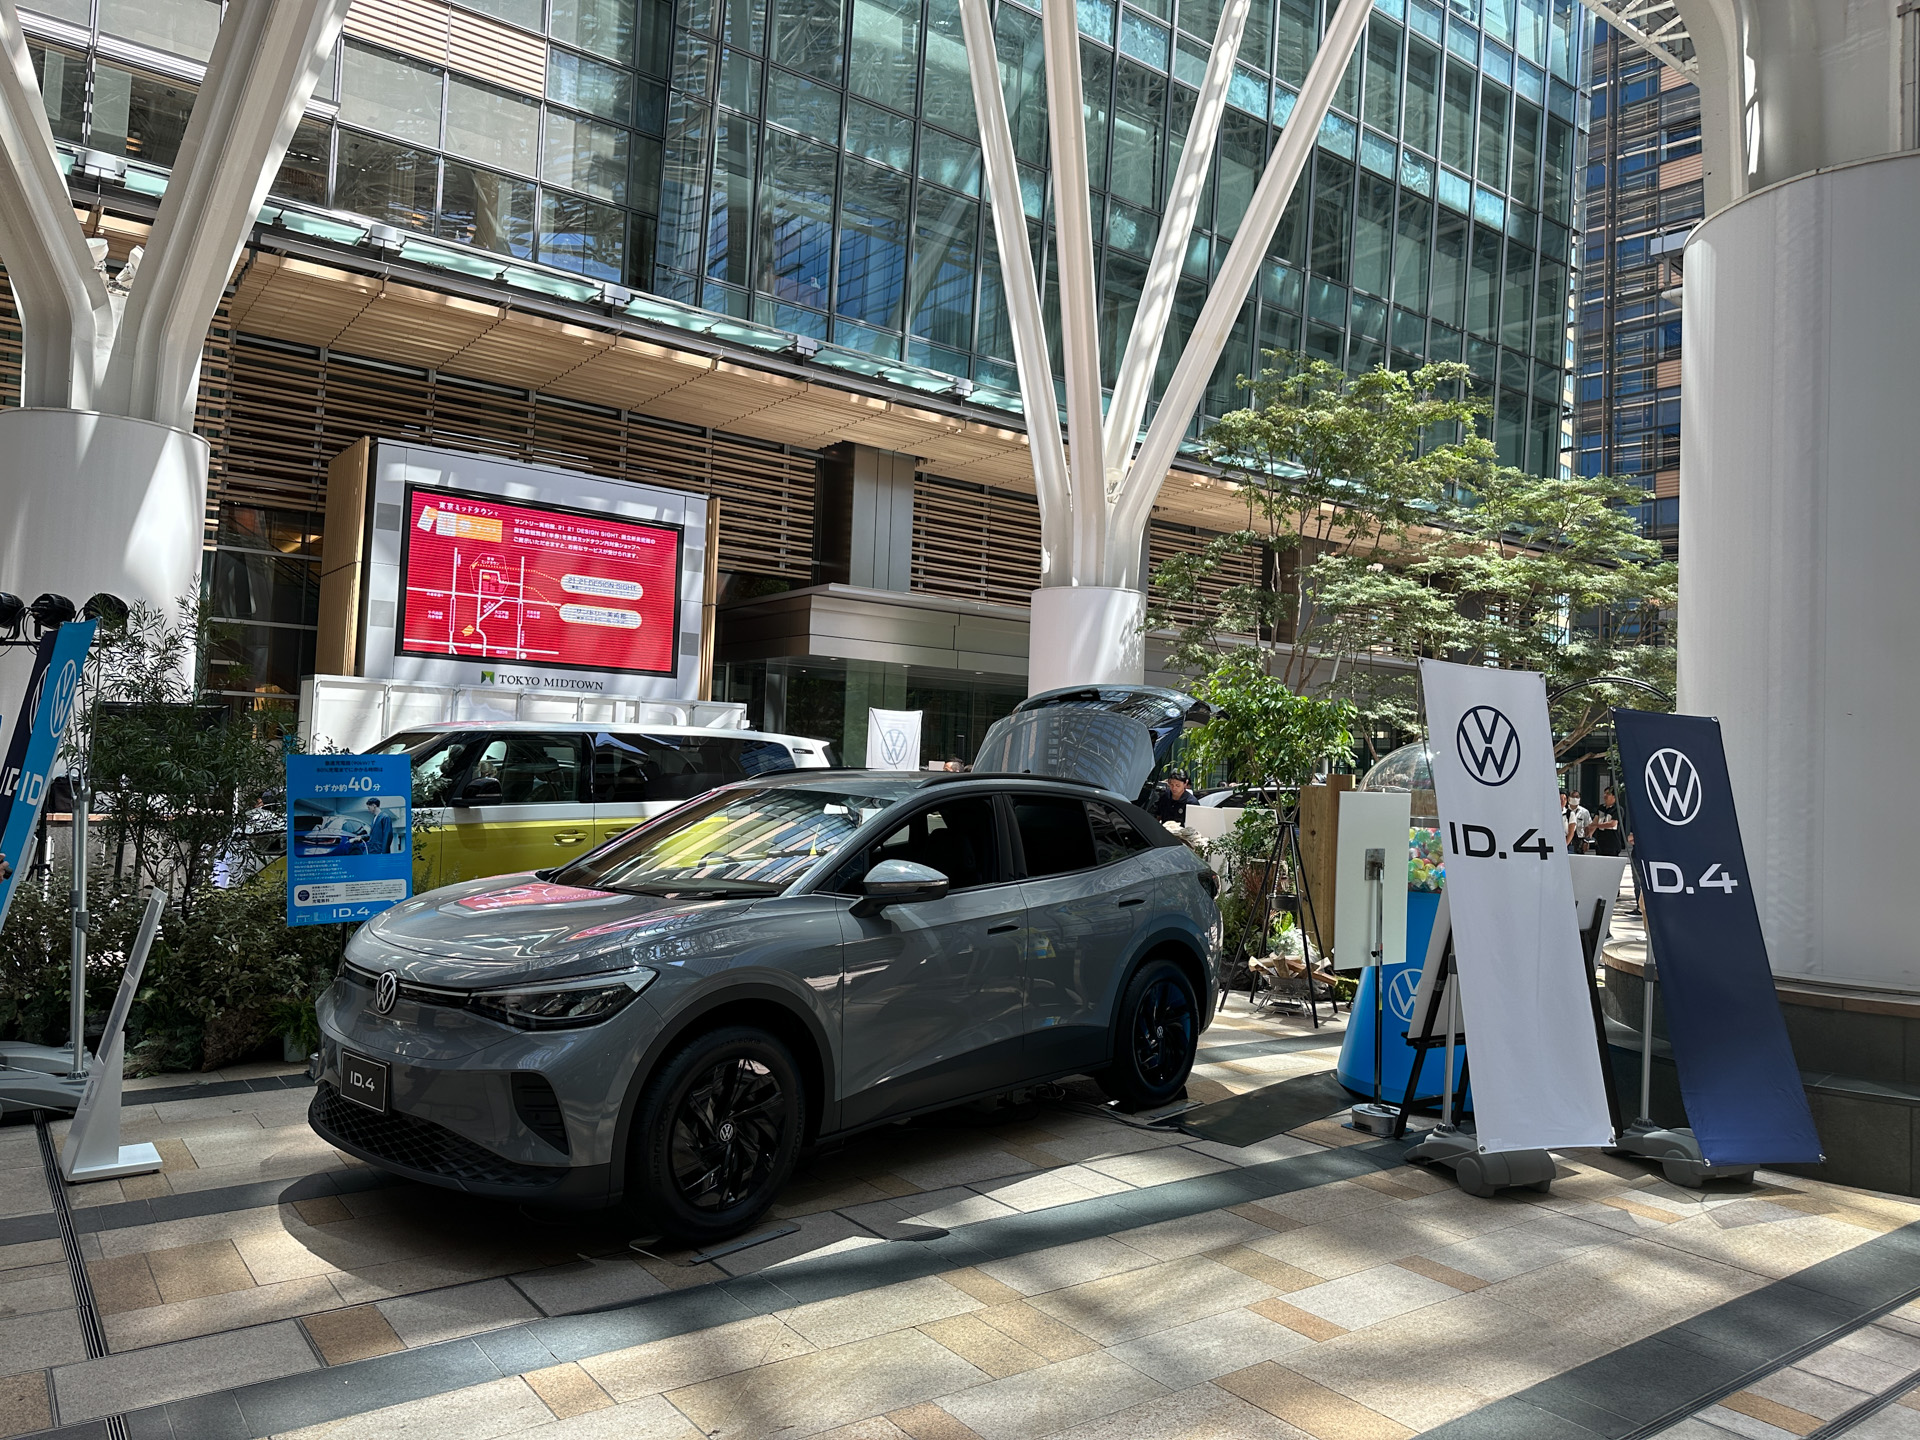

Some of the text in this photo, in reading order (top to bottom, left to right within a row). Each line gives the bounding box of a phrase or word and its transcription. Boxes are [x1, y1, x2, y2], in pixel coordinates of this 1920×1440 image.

[498, 674, 604, 691] TOKYO MIDTOWN
[314, 776, 381, 793] わずか約40分
[1449, 821, 1555, 861] ID.4
[332, 906, 371, 918] ID.4
[350, 1070, 375, 1092] ID.4
